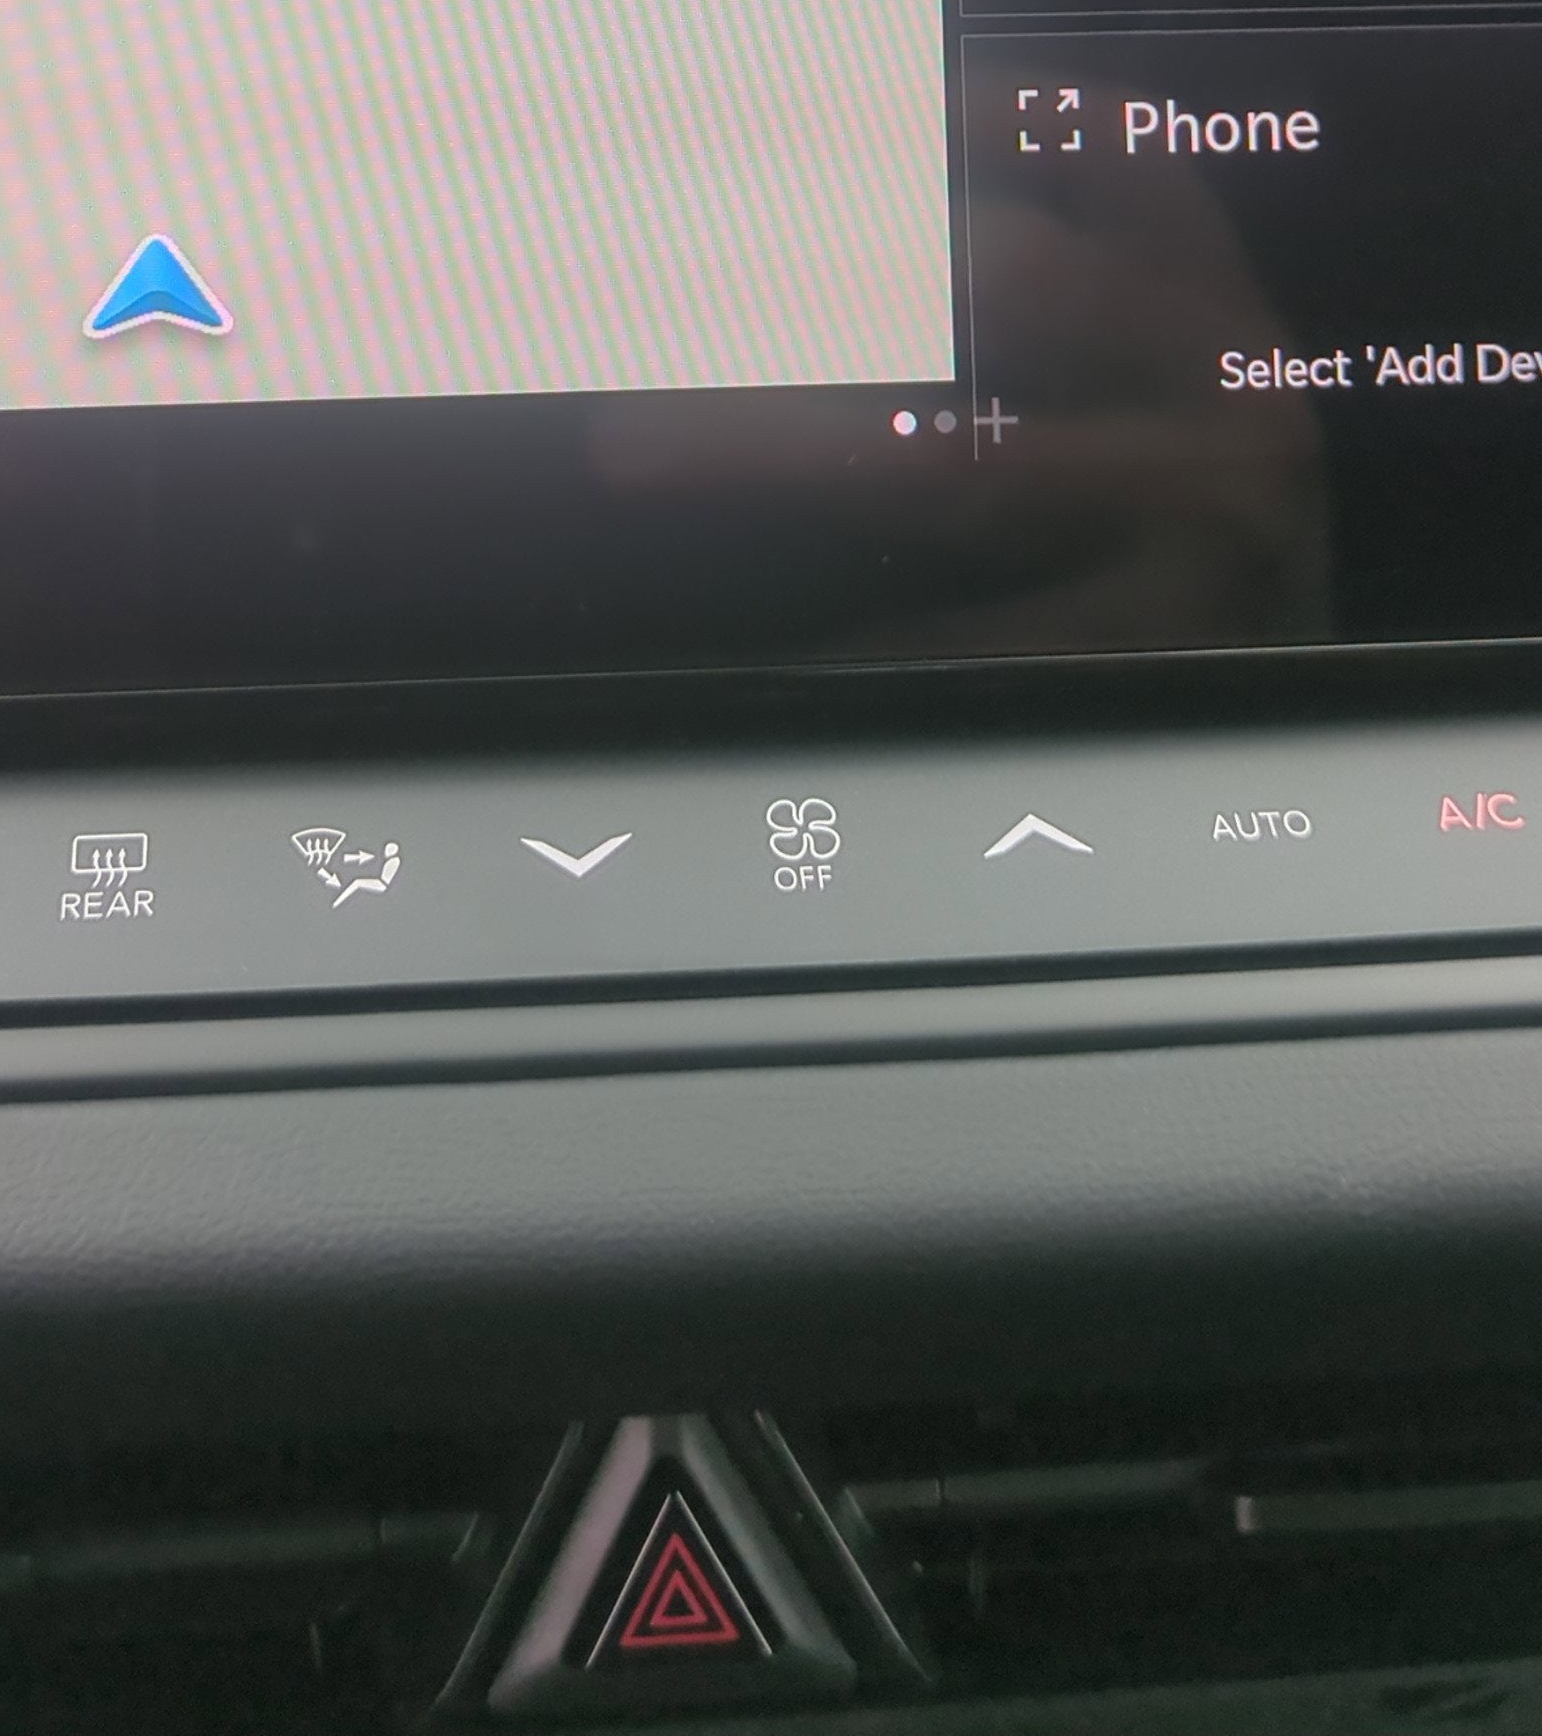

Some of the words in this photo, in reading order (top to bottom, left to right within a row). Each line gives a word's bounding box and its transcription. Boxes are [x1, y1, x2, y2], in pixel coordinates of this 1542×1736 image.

[1123, 100, 1321, 153] Phone
[1219, 347, 1352, 389] Select
[1365, 342, 1464, 386] 'Add
[1212, 810, 1312, 842] AUTO
[1438, 794, 1525, 831] A/C
[774, 865, 839, 890] OFF
[60, 889, 154, 920] REAR
